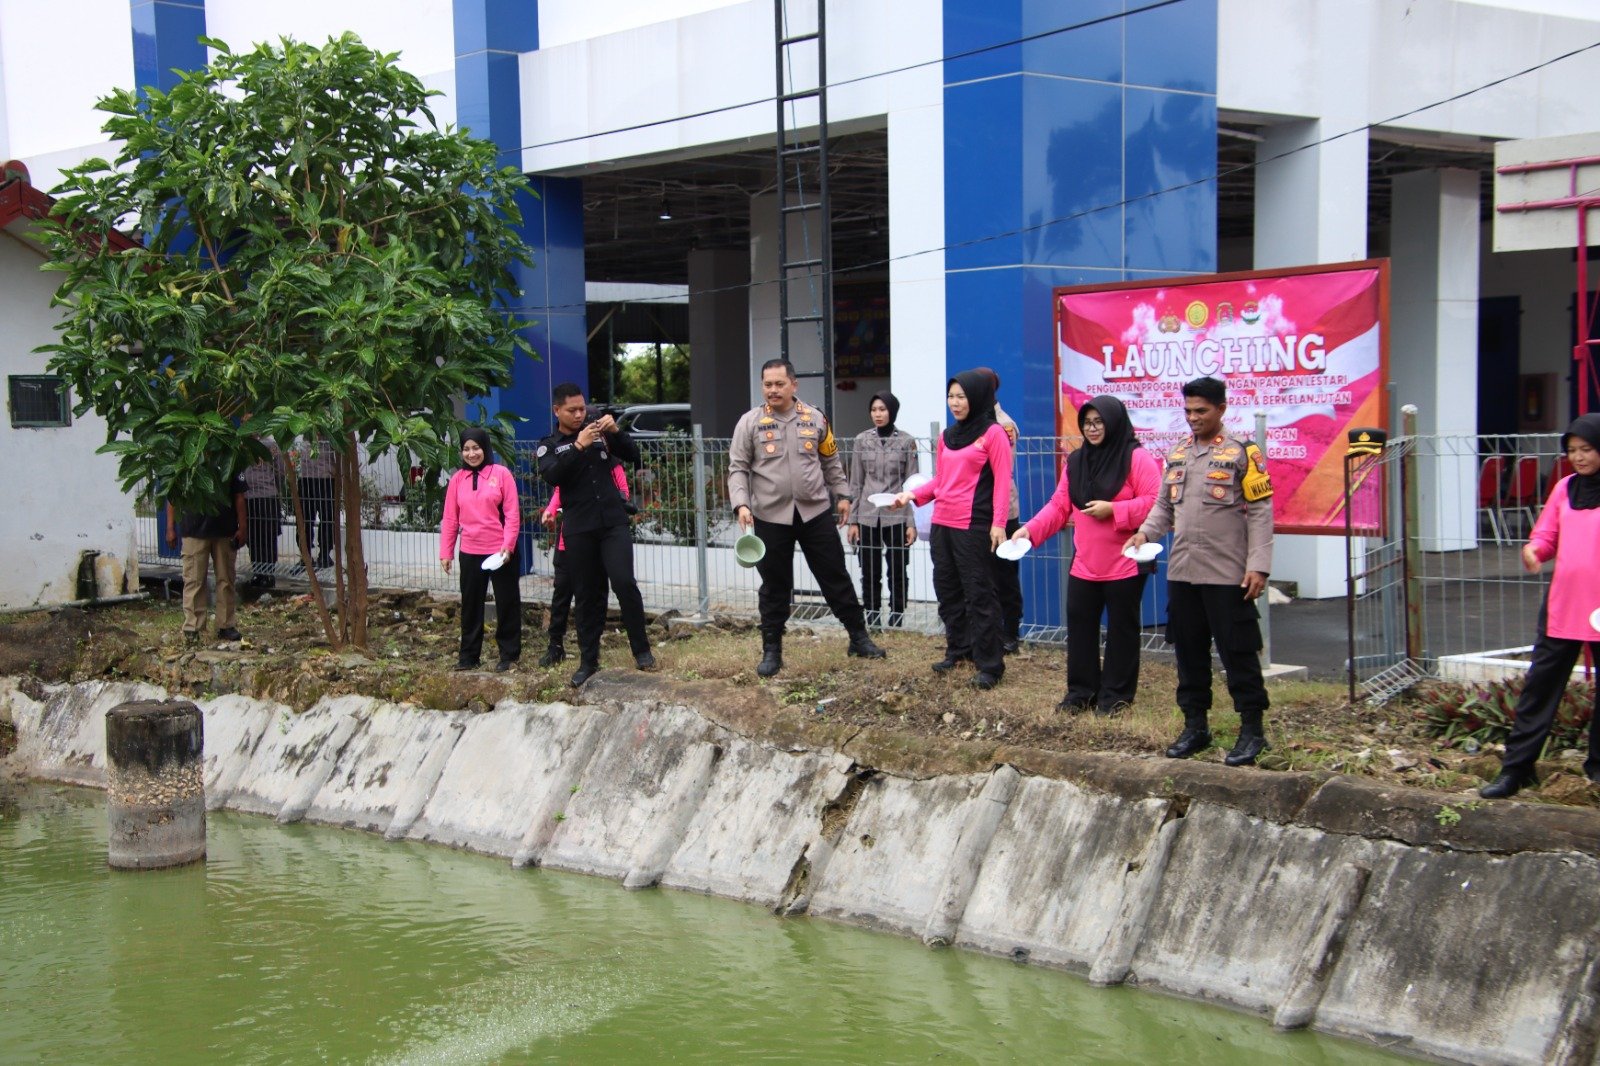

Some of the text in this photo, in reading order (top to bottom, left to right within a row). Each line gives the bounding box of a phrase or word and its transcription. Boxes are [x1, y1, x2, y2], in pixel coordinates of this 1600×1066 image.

[1101, 333, 1326, 380] LAUNCHING
[1086, 383, 1140, 394] PENGUATAN
[1260, 377, 1303, 387] PANGAN
[1306, 375, 1347, 385] LESTARI
[1263, 391, 1350, 405] BERKELANJUTAN
[1268, 447, 1306, 457] GRATIS
